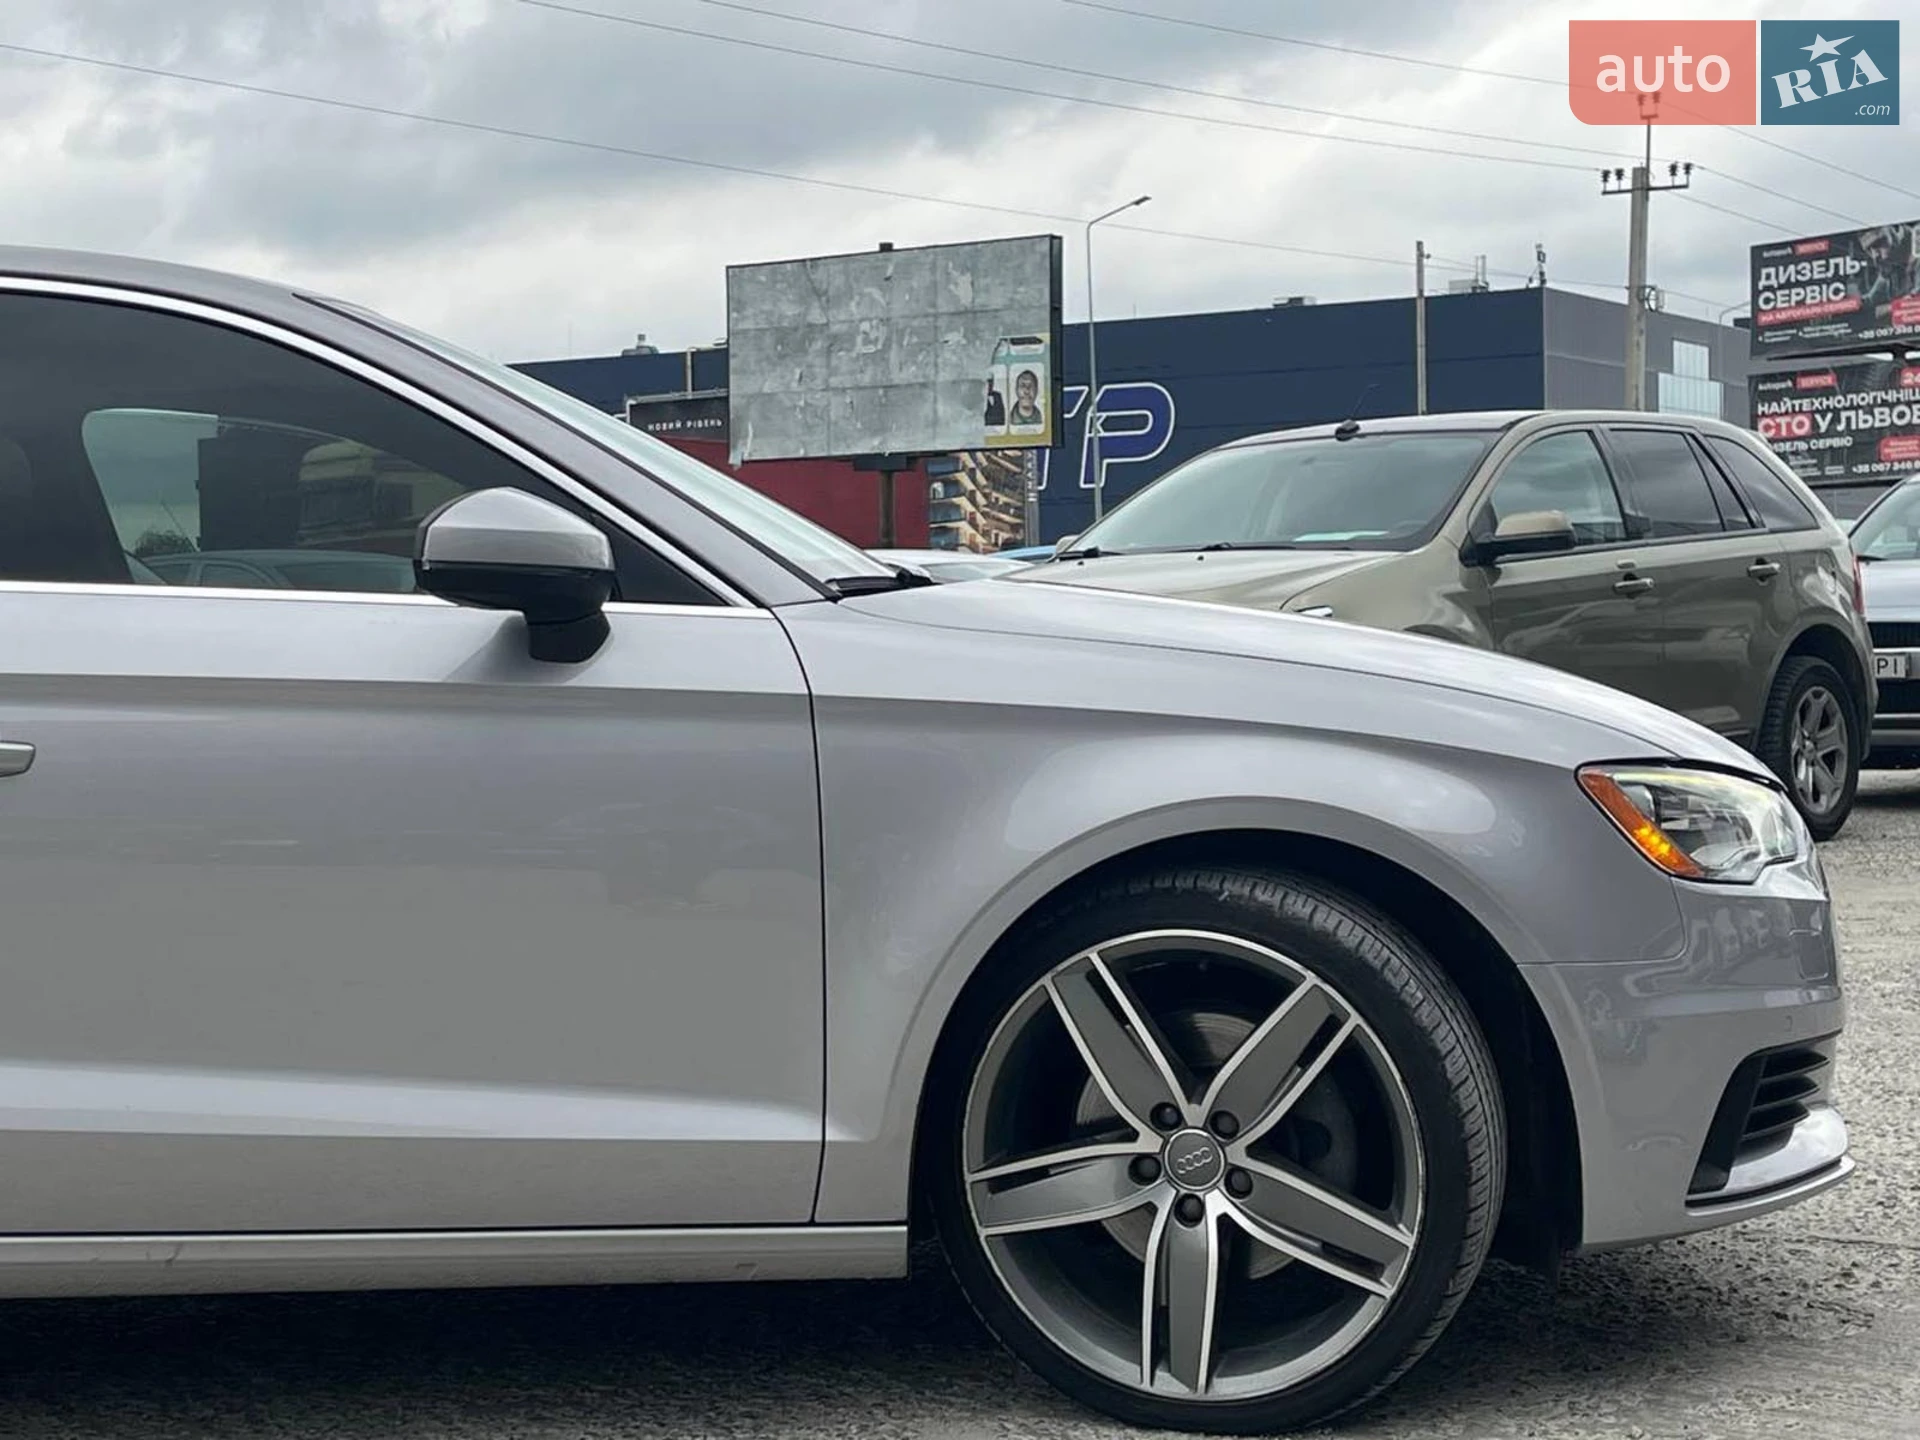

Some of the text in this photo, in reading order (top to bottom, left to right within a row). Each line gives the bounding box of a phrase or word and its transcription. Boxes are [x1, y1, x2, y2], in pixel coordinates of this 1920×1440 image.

[1758, 256, 1867, 290] ДИЗЕЛЬ-
[1758, 282, 1846, 311] СЕРВІС
[1758, 415, 1811, 437] СТО
[1814, 412, 1833, 433] У
[1772, 436, 1853, 452] ИЗЕЛЬ СЕРВІС
